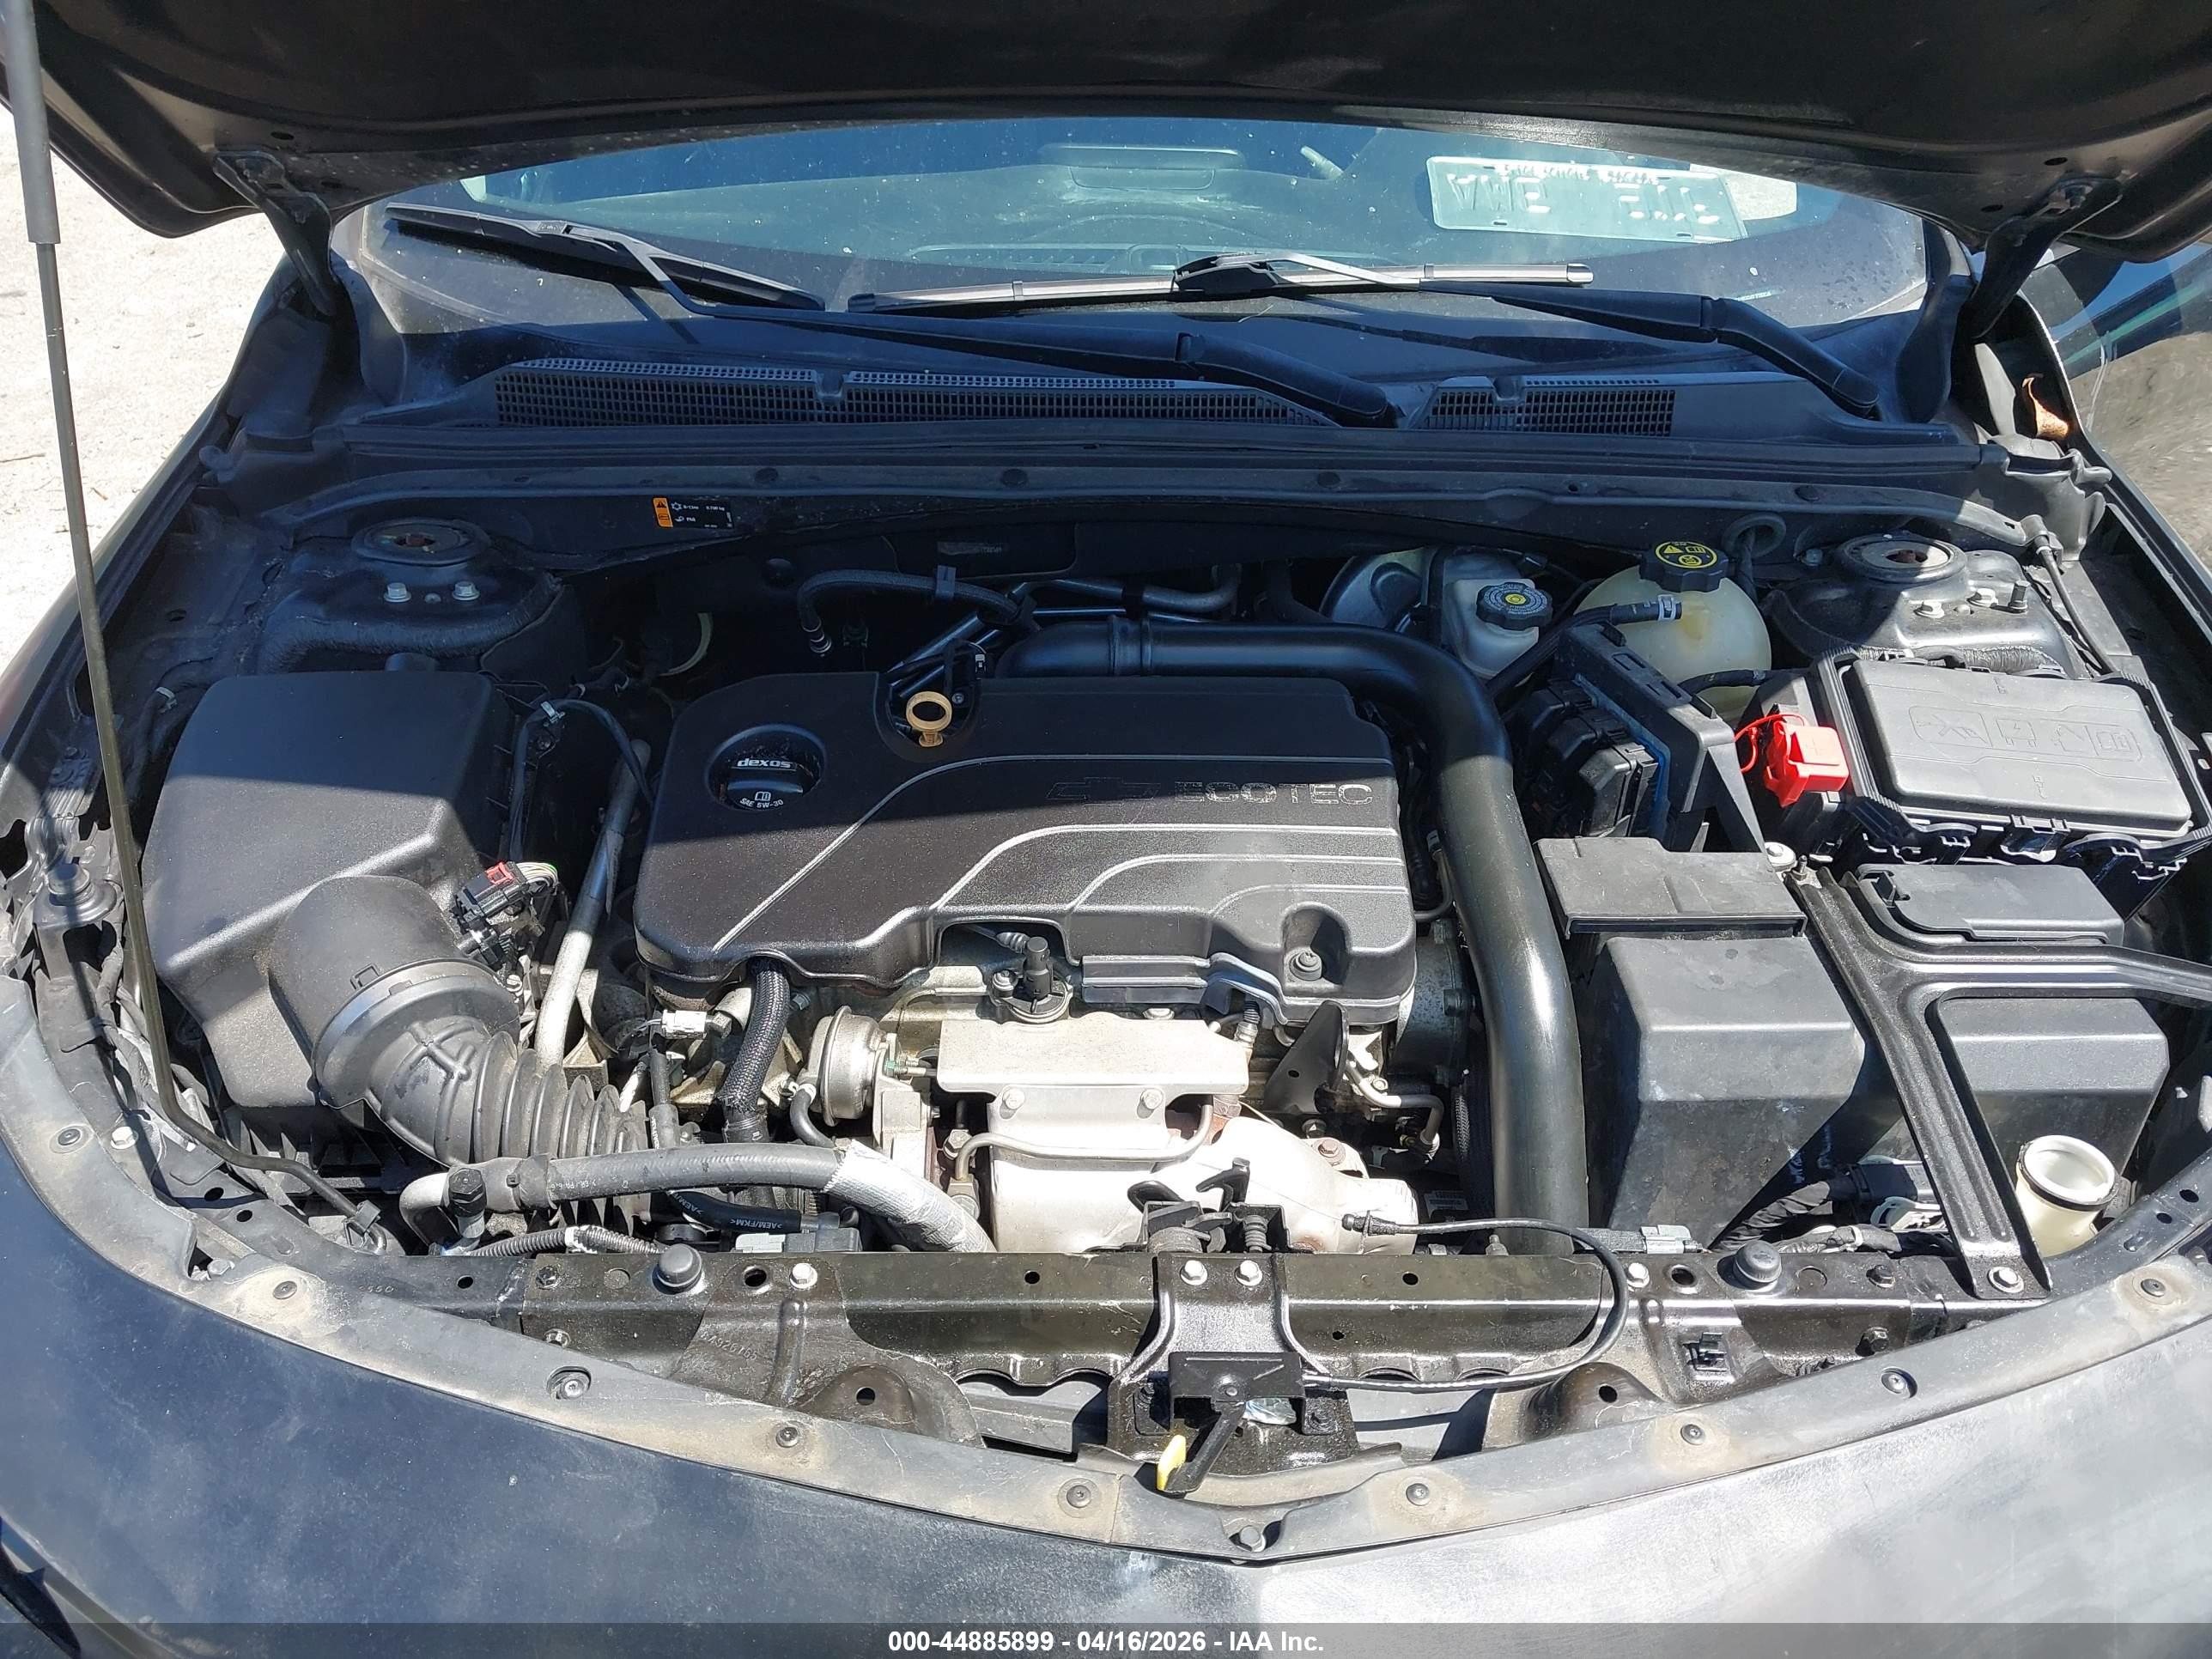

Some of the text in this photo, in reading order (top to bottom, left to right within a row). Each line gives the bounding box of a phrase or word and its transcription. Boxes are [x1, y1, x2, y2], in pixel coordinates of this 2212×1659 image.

[737, 758, 792, 769] dexos
[1175, 781, 1373, 805] ECOTEC
[739, 798, 784, 809] SAE 5W-30
